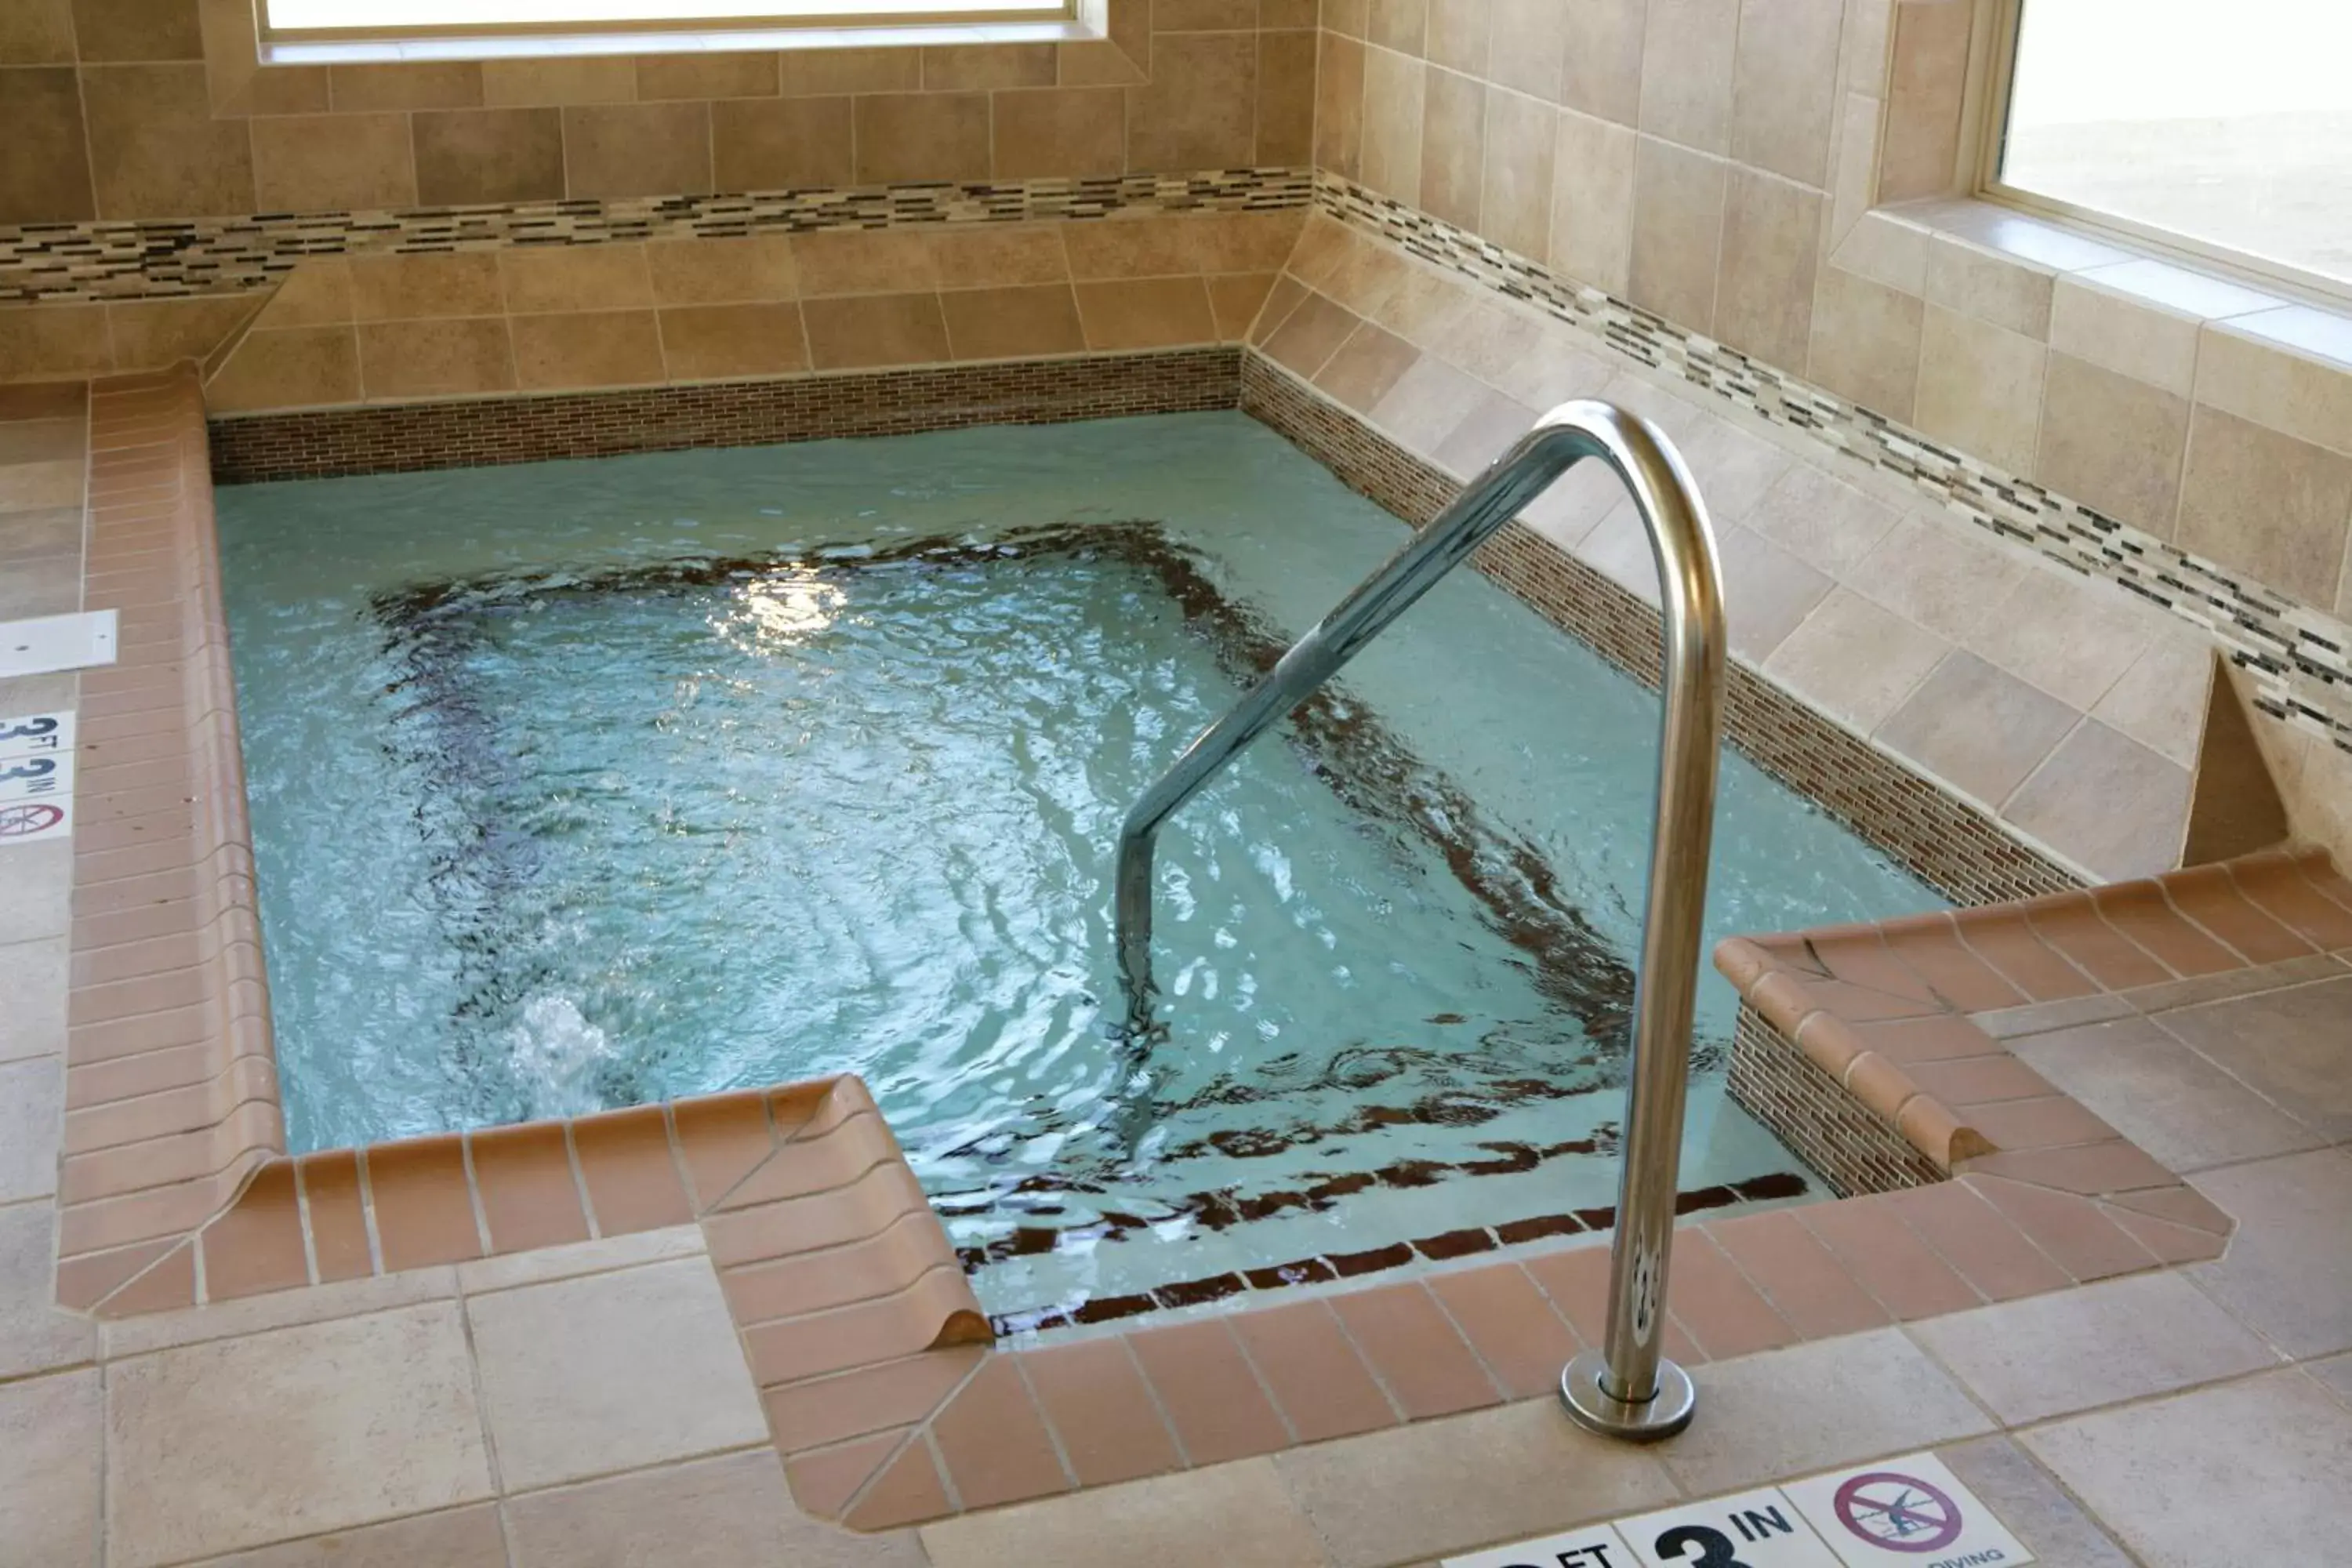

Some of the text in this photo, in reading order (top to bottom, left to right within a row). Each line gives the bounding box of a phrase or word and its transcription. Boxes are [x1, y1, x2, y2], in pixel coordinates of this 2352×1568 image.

[0, 717, 58, 793] 3 FT 3 IN
[1556, 1544, 1613, 1568] FT
[1728, 1505, 1795, 1541] IN
